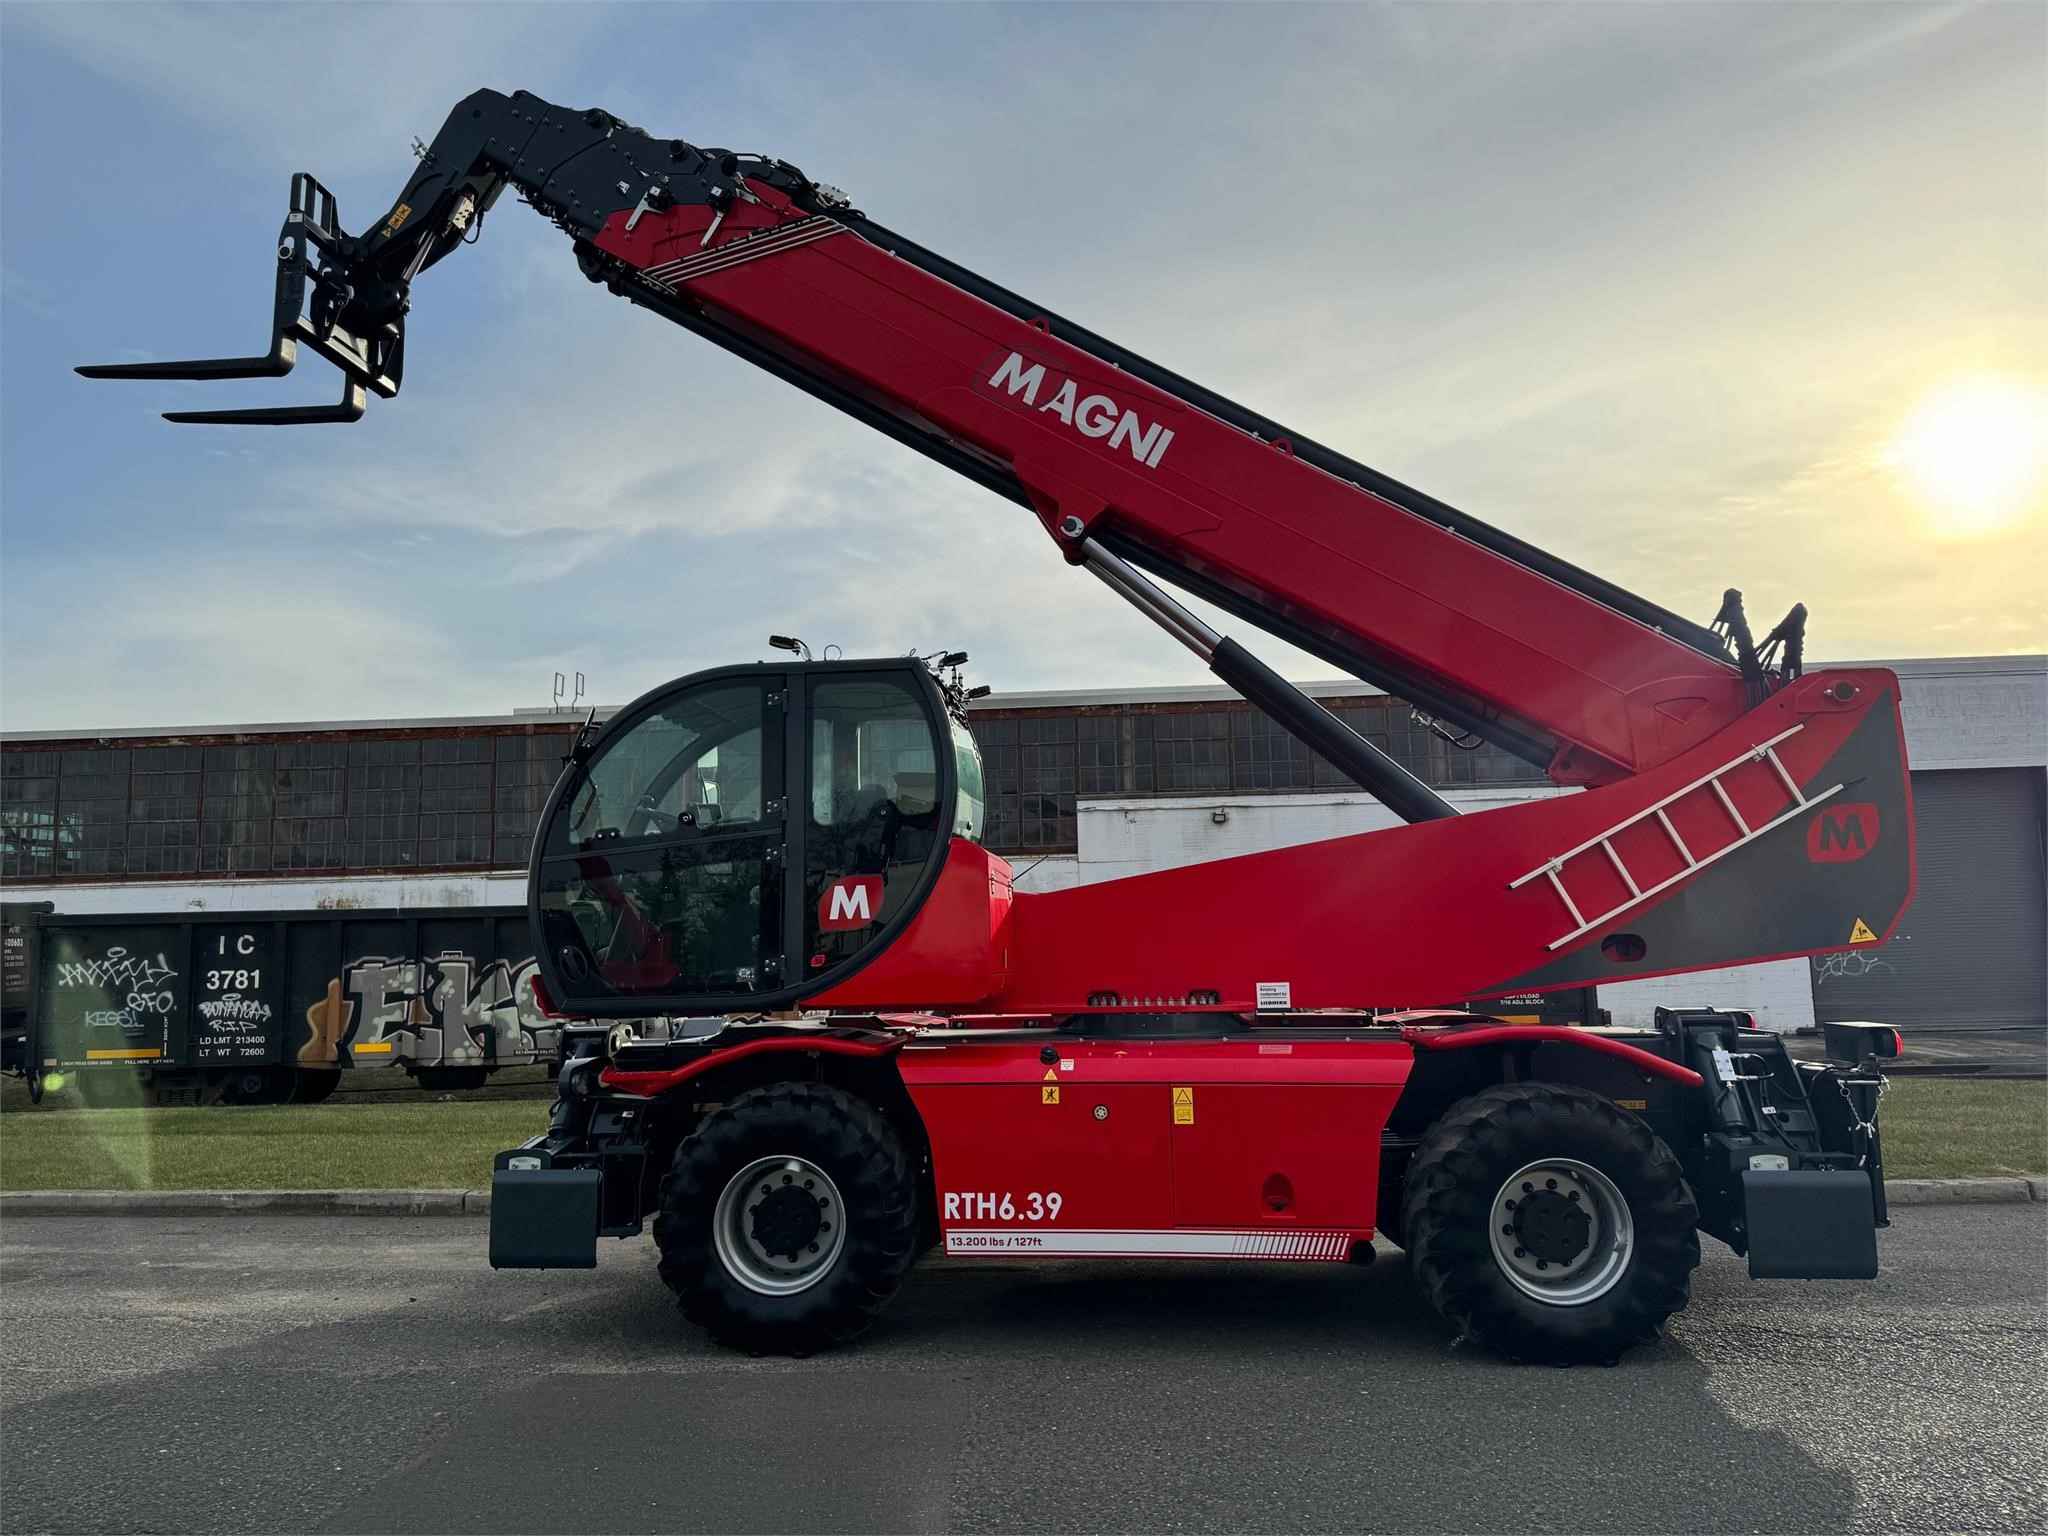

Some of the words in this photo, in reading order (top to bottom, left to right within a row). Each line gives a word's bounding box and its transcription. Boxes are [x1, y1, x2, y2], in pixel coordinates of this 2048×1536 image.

[987, 351, 1176, 469] MAGNI
[829, 884, 871, 920] M
[236, 934, 255, 955] C
[206, 969, 260, 990] 3781
[200, 1037, 211, 1045] LD
[213, 1036, 231, 1044] LMT
[235, 1036, 265, 1044] 213400
[240, 1048, 265, 1056] 72600
[944, 1192, 1062, 1220] RTH6.39
[951, 1237, 986, 1246] 13.200
[990, 1237, 1004, 1246] lbs
[1015, 1237, 1043, 1246] 127ft
